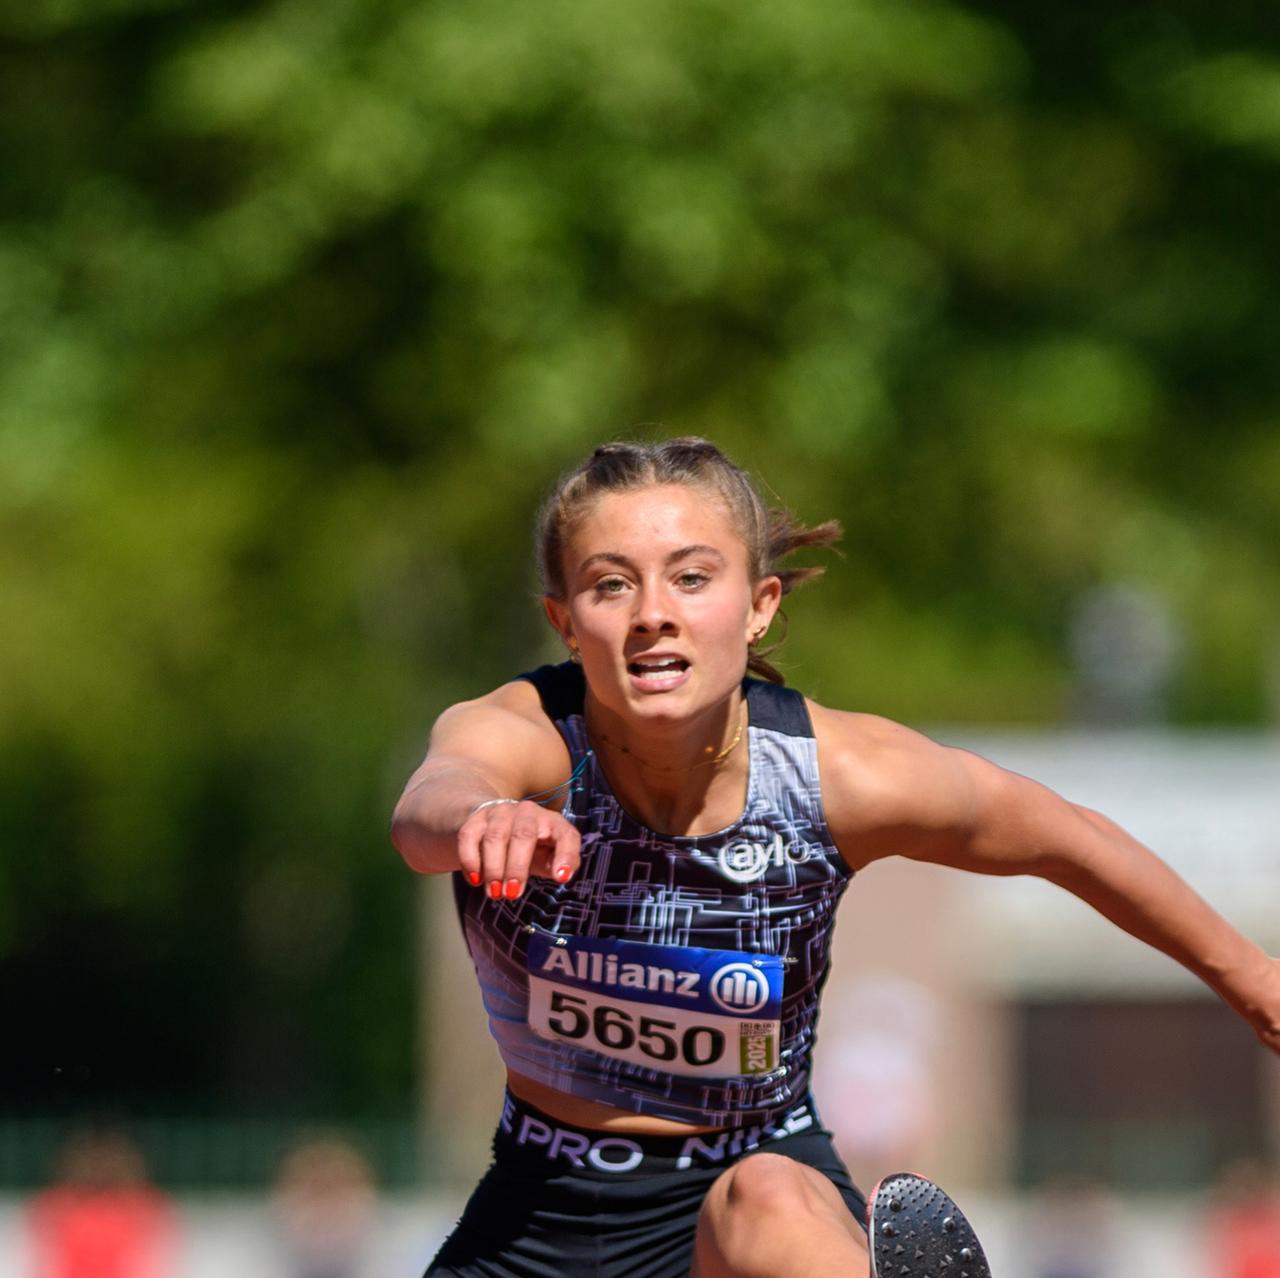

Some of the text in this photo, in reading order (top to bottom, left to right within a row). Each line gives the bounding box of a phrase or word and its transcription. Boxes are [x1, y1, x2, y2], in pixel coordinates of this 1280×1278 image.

[542, 946, 701, 998] Allianz
[548, 990, 725, 1066] 5650
[517, 1115, 644, 1173] PRO
[675, 1103, 813, 1171] NIKE
